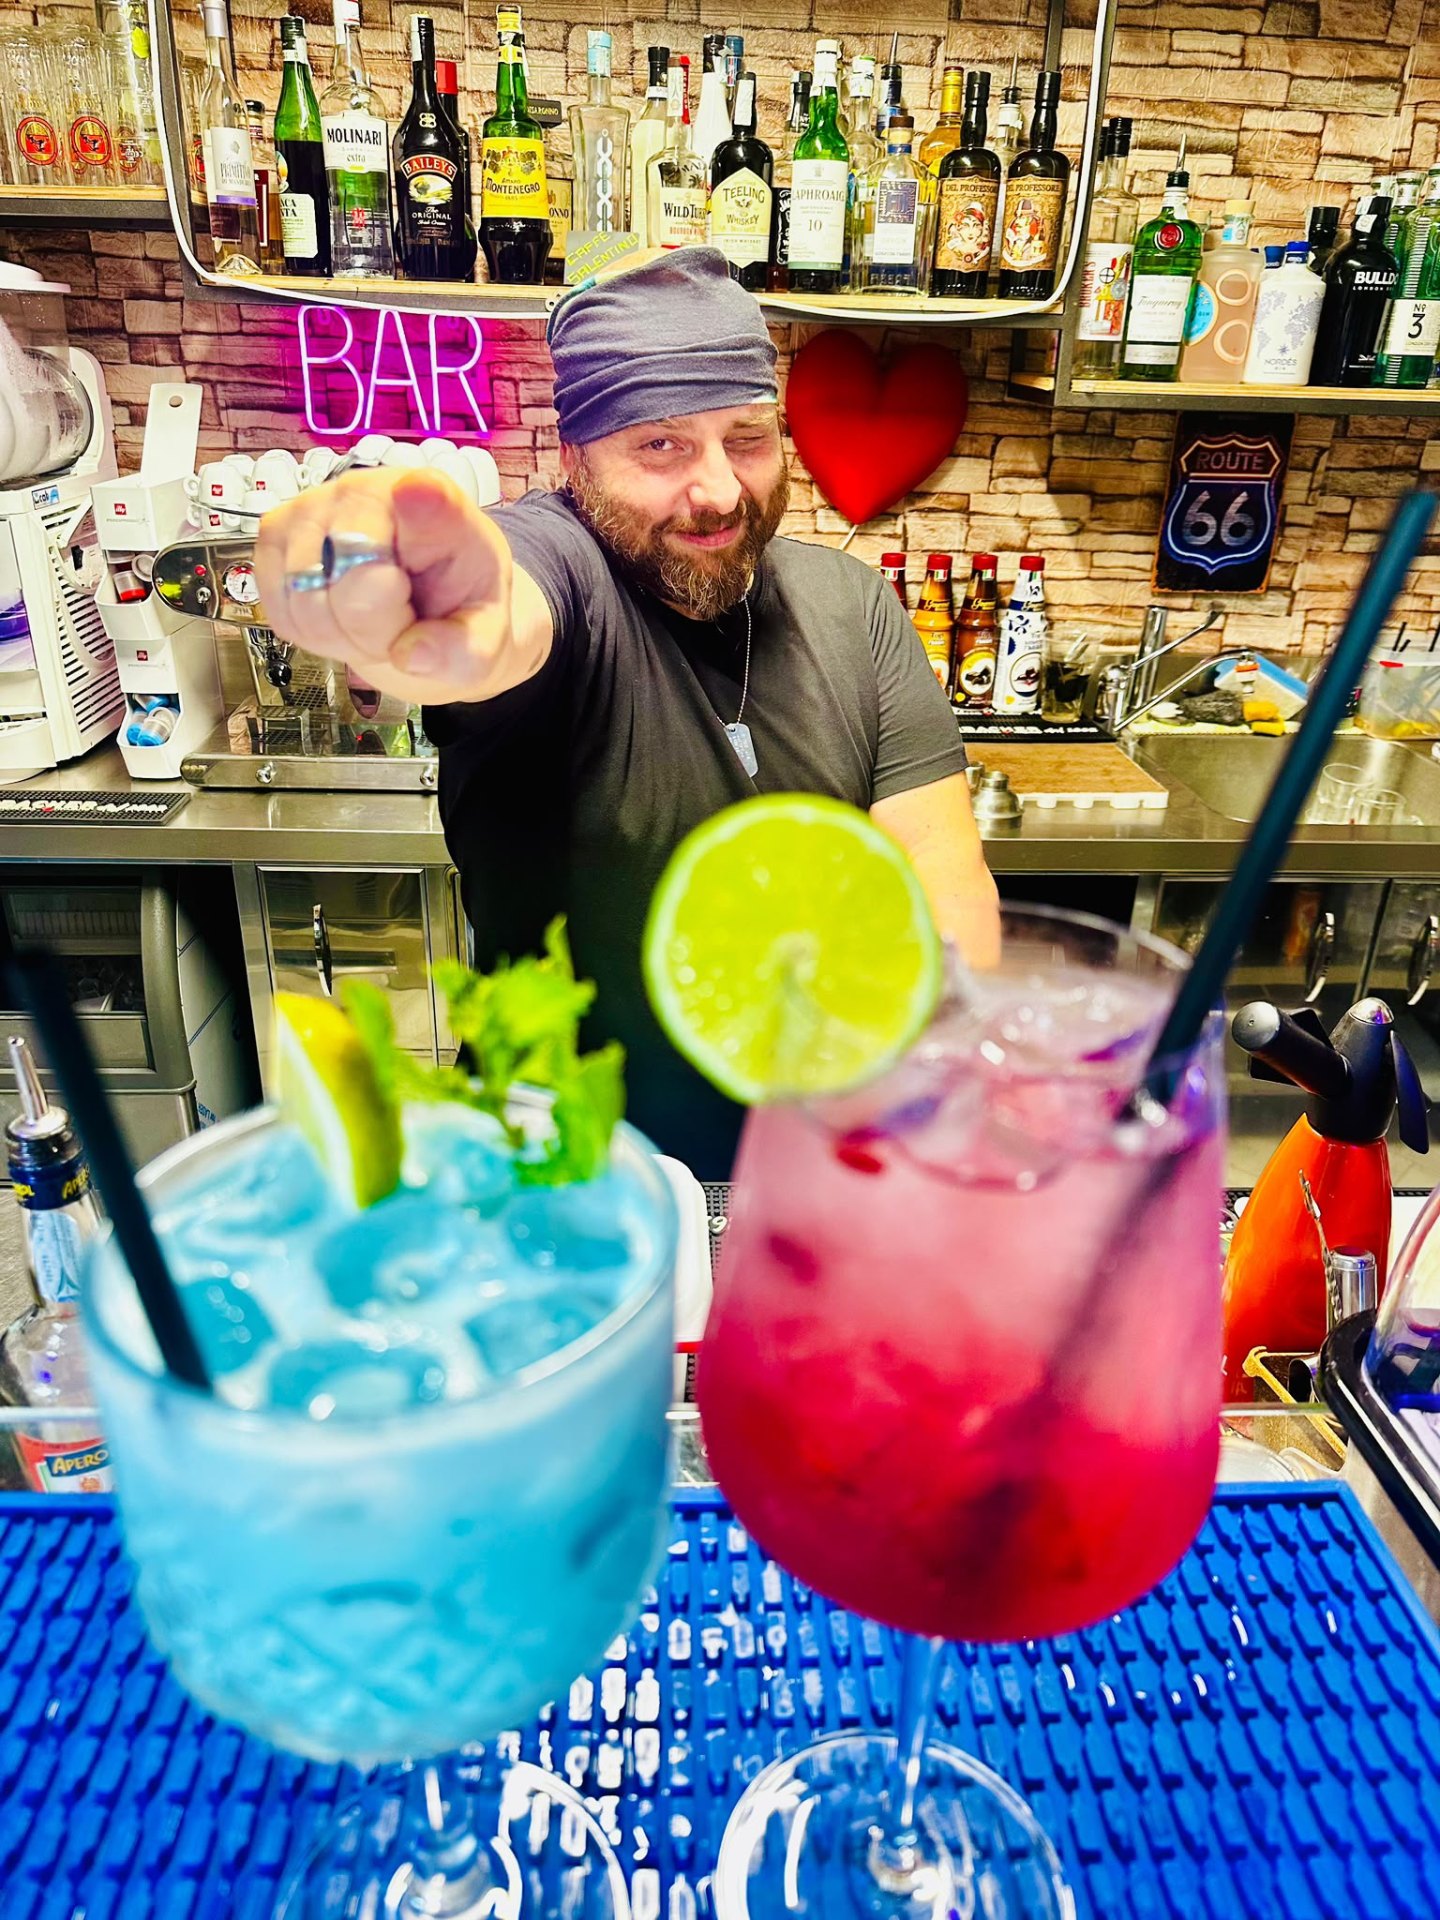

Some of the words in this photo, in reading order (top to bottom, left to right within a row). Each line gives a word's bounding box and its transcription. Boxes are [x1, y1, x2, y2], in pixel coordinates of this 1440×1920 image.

[326, 128, 382, 146] MOLINARI
[404, 157, 454, 175] BAILEYS
[485, 177, 541, 194] MONTENEGRO
[945, 184, 959, 192] DEL
[1015, 184, 1061, 192] PROFESSORE
[723, 186, 765, 203] TEELING
[411, 212, 452, 220] ORIGINAL
[664, 202, 690, 218] WILD
[726, 214, 760, 225] WHISKEY
[808, 219, 823, 232] 10
[567, 232, 640, 284] SALENTINO
[1407, 313, 1426, 339] 3
[298, 305, 488, 434] BAR
[1195, 451, 1266, 470] ROUTE
[1182, 490, 1255, 546] 66
[52, 1449, 109, 1475] APERO
